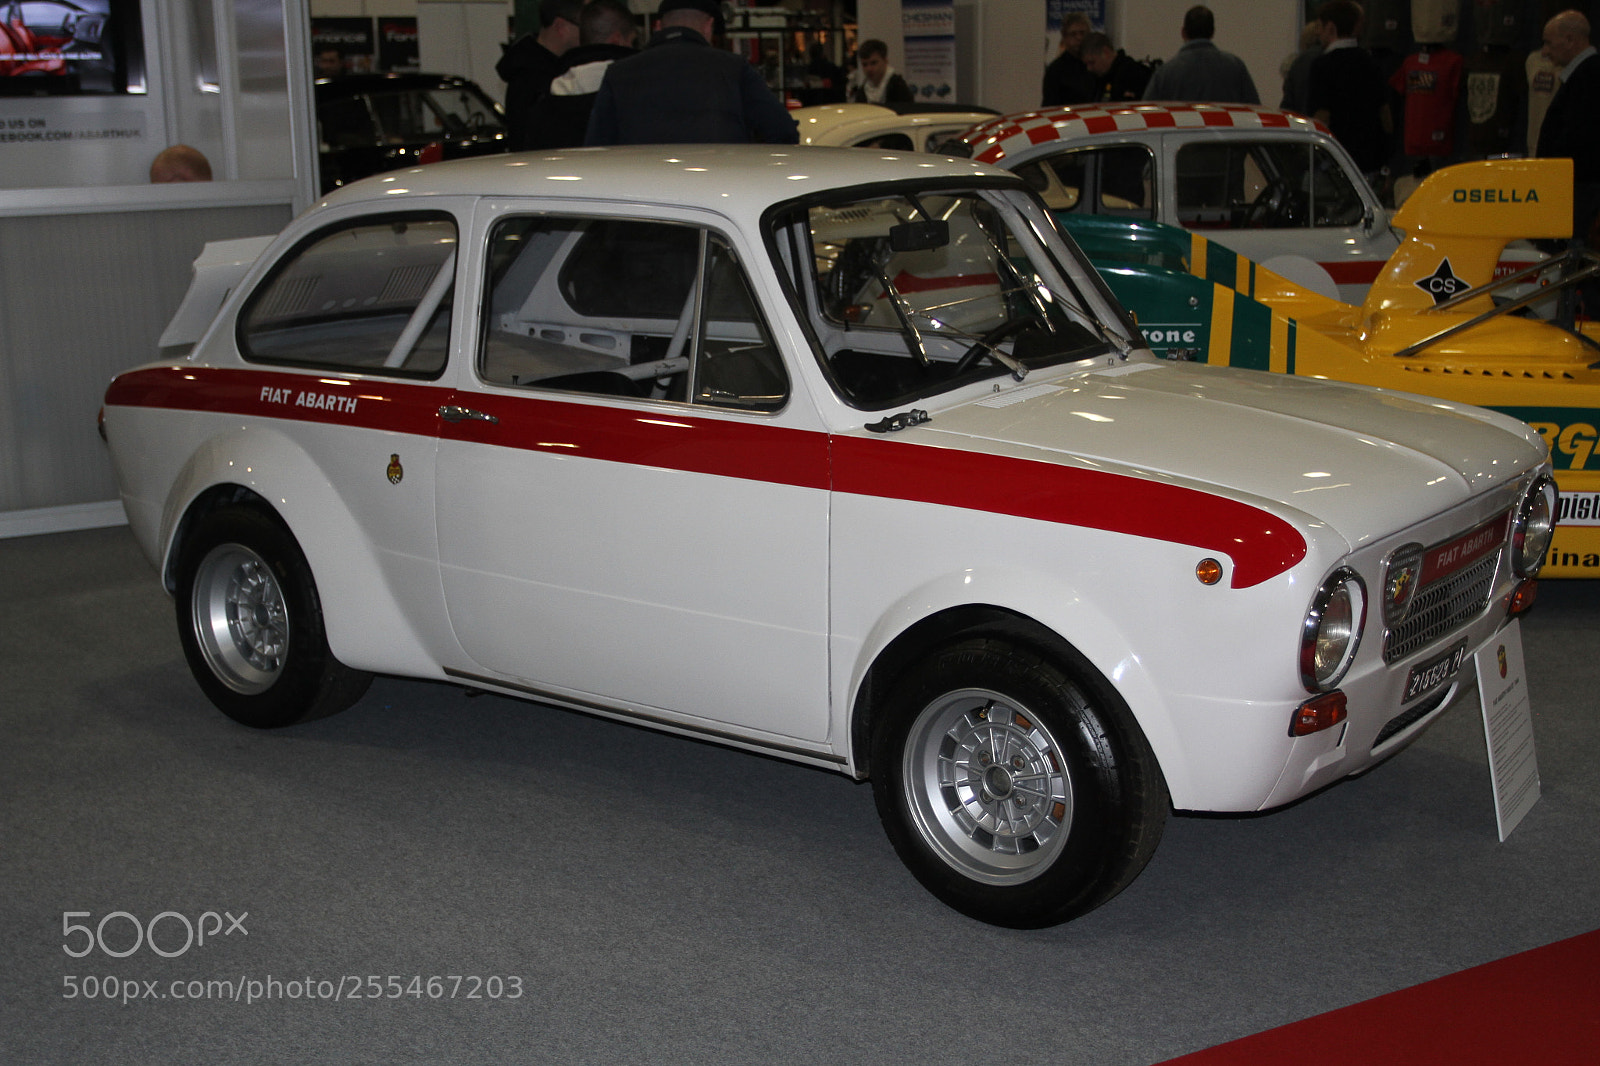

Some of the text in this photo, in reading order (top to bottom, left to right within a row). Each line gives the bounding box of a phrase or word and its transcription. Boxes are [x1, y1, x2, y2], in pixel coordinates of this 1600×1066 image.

[1453, 189, 1539, 203] OSELLA
[1430, 278, 1456, 293] CS
[260, 386, 358, 413] FIAT ABARTH
[1436, 546, 1460, 569] FIAT
[1460, 527, 1494, 558] ABARTH
